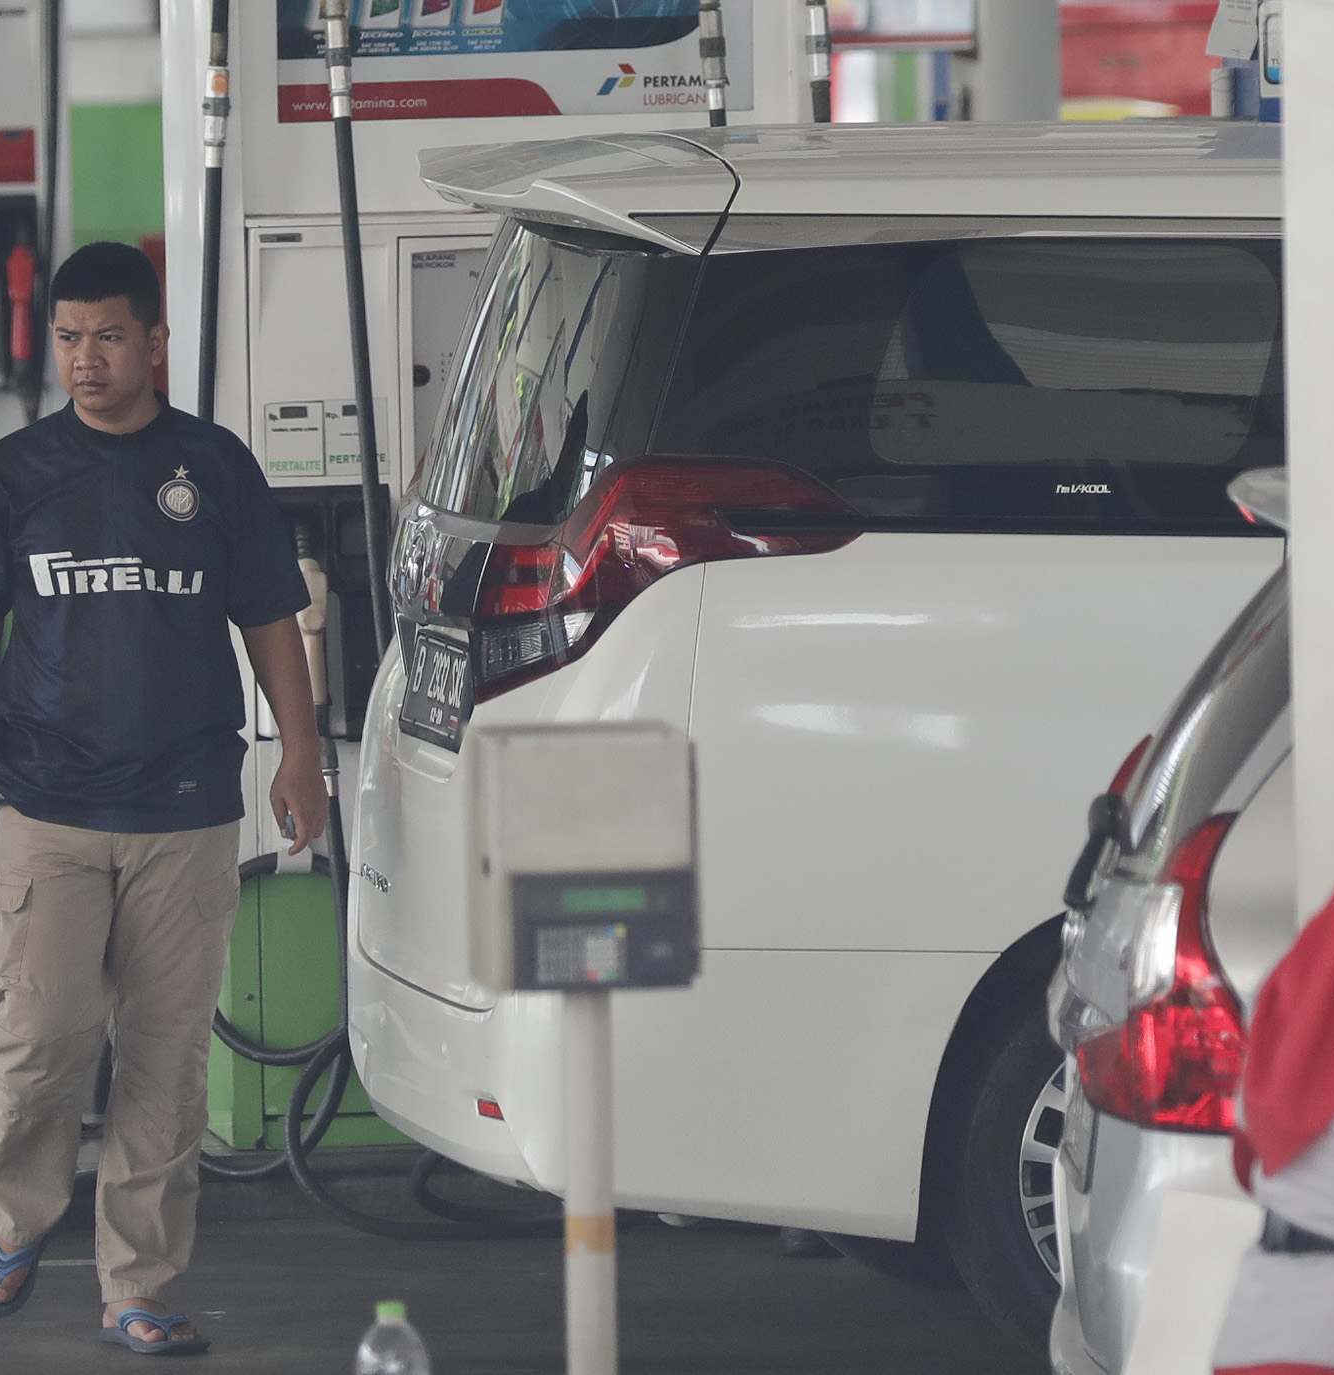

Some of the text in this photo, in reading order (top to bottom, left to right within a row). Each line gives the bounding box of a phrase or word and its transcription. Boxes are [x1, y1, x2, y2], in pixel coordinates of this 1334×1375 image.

[643, 74, 731, 88] PERTAMA
[292, 94, 428, 113] www.tamina.com
[643, 92, 707, 107] LUBRICAN
[268, 459, 322, 472] PERTALITE
[328, 452, 386, 465] PERTAE
[412, 645, 427, 693] B
